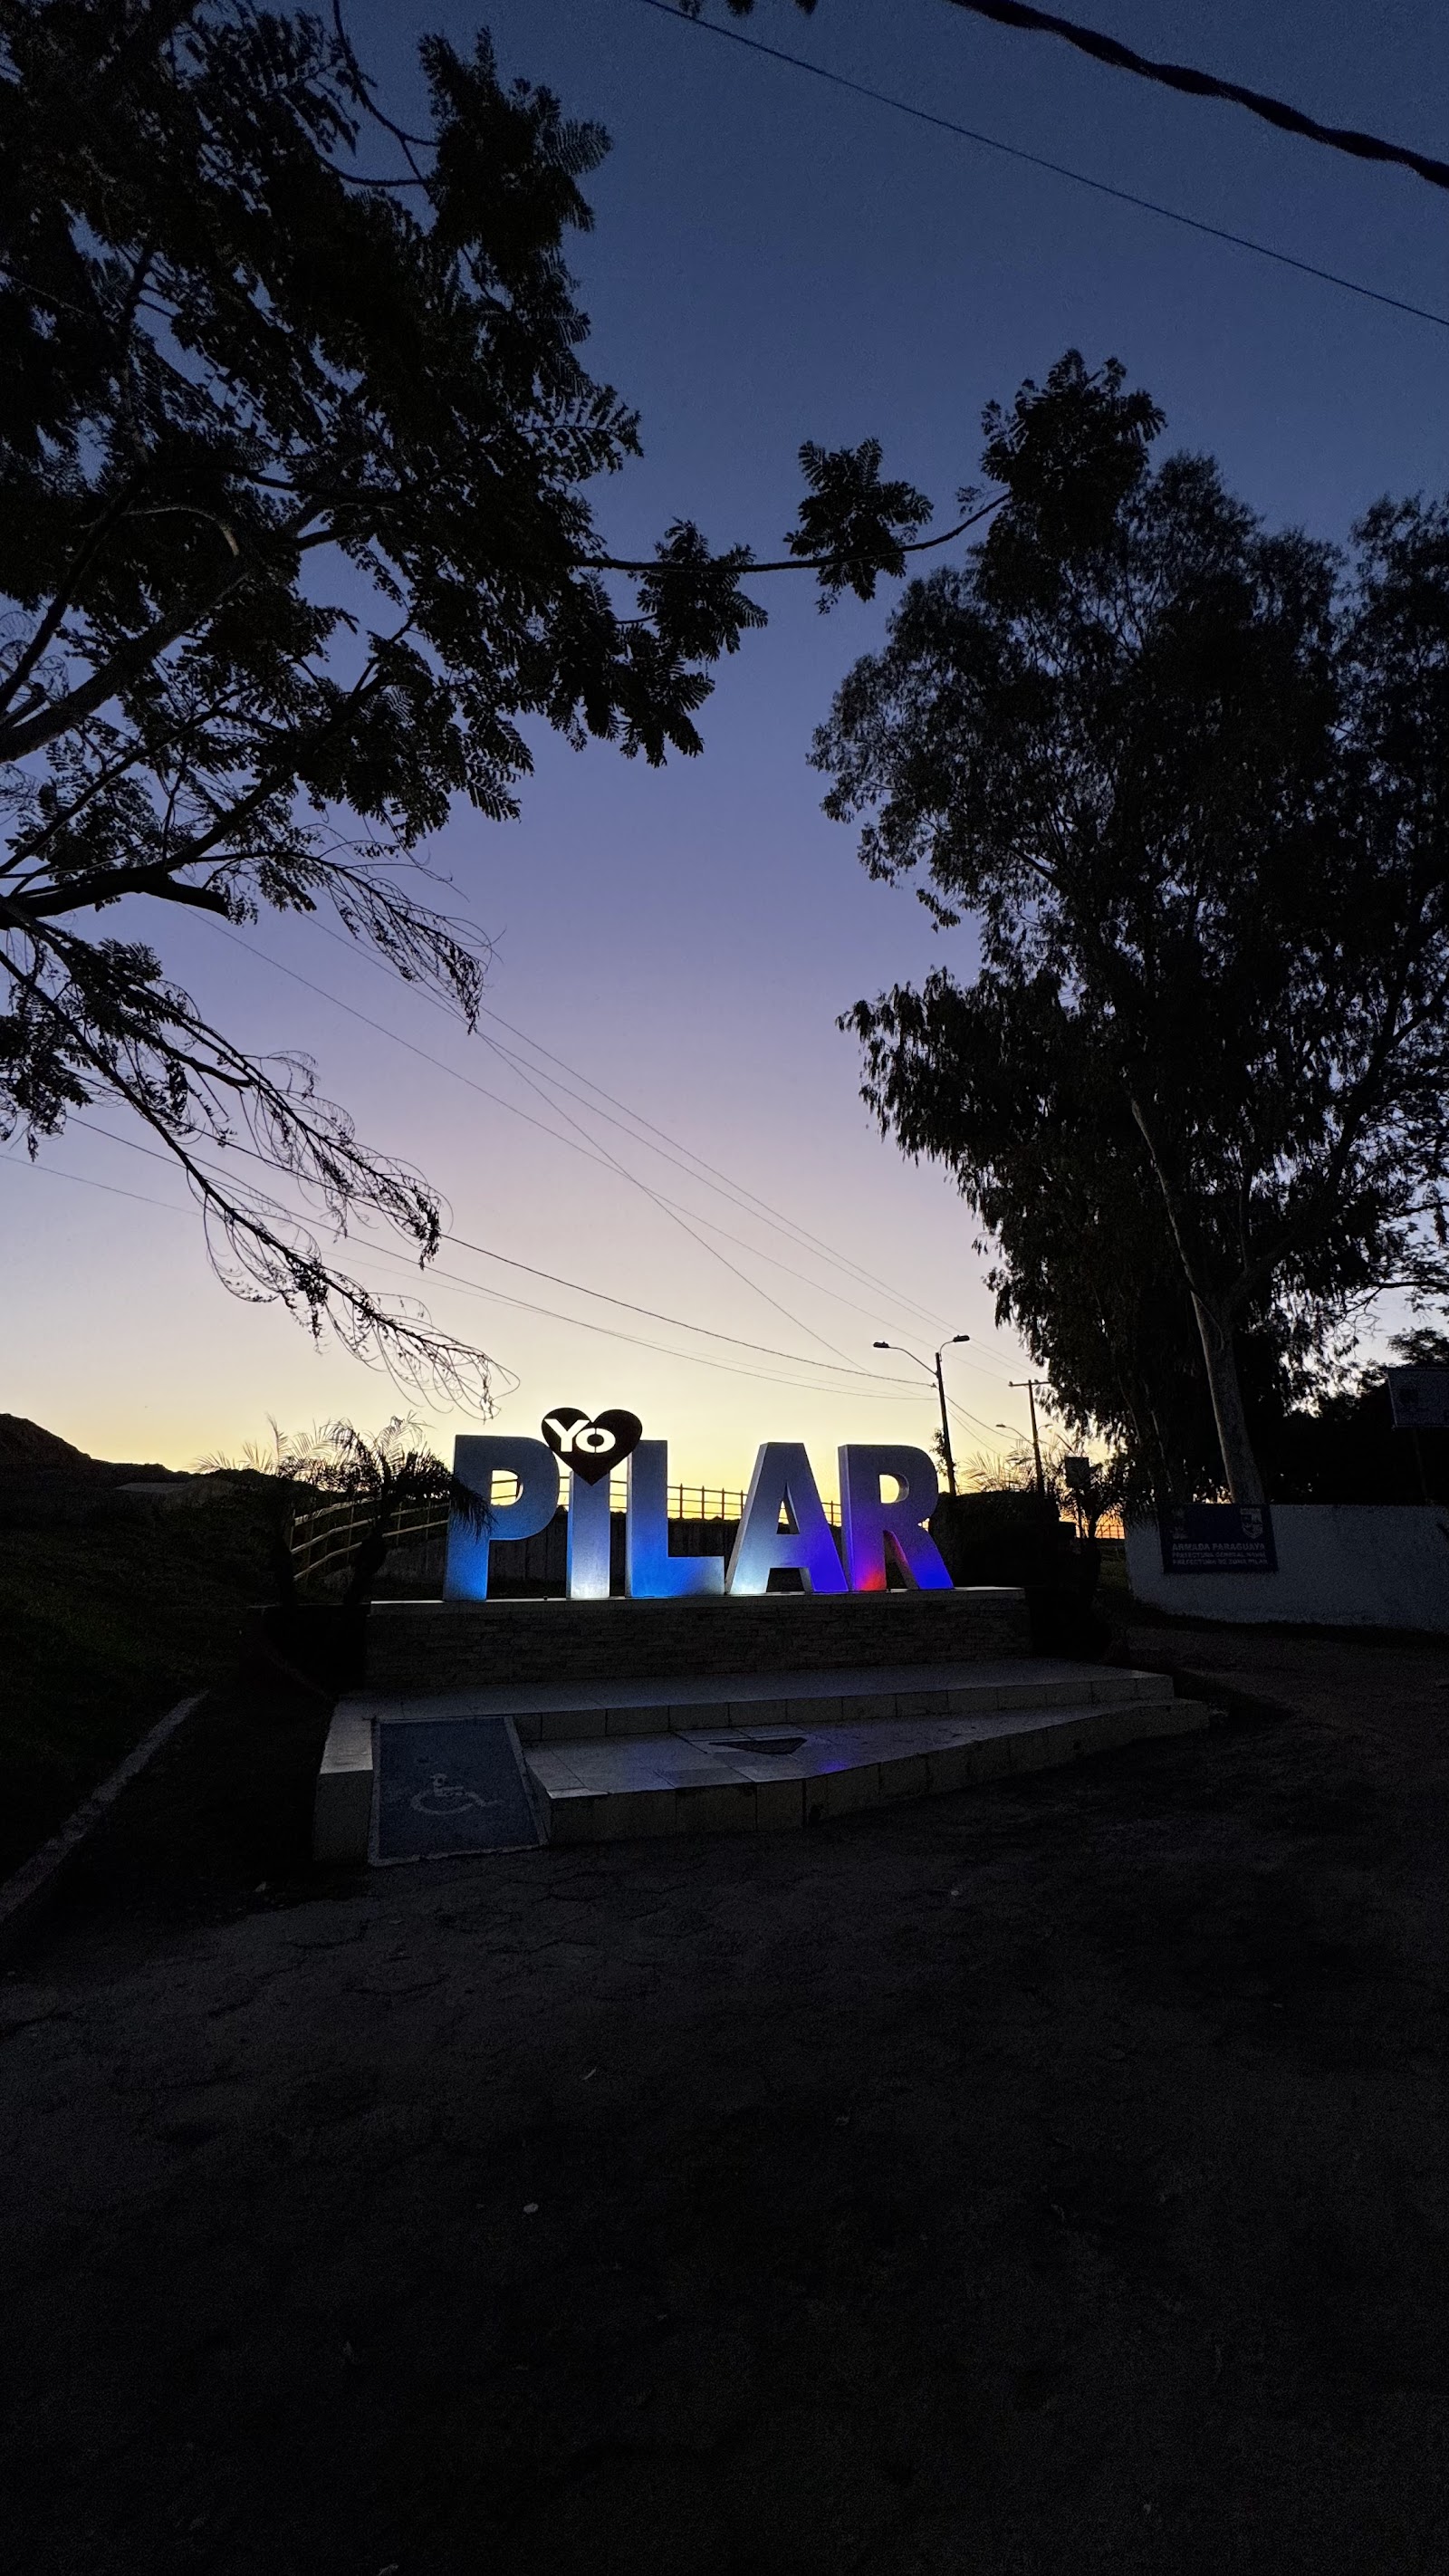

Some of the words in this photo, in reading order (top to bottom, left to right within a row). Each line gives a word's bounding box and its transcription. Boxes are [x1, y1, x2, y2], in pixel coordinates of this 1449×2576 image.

[442, 1435, 955, 1602] PILAR
[1172, 1543, 1210, 1551] ARMADA
[1212, 1543, 1265, 1551] PARAGUAYA
